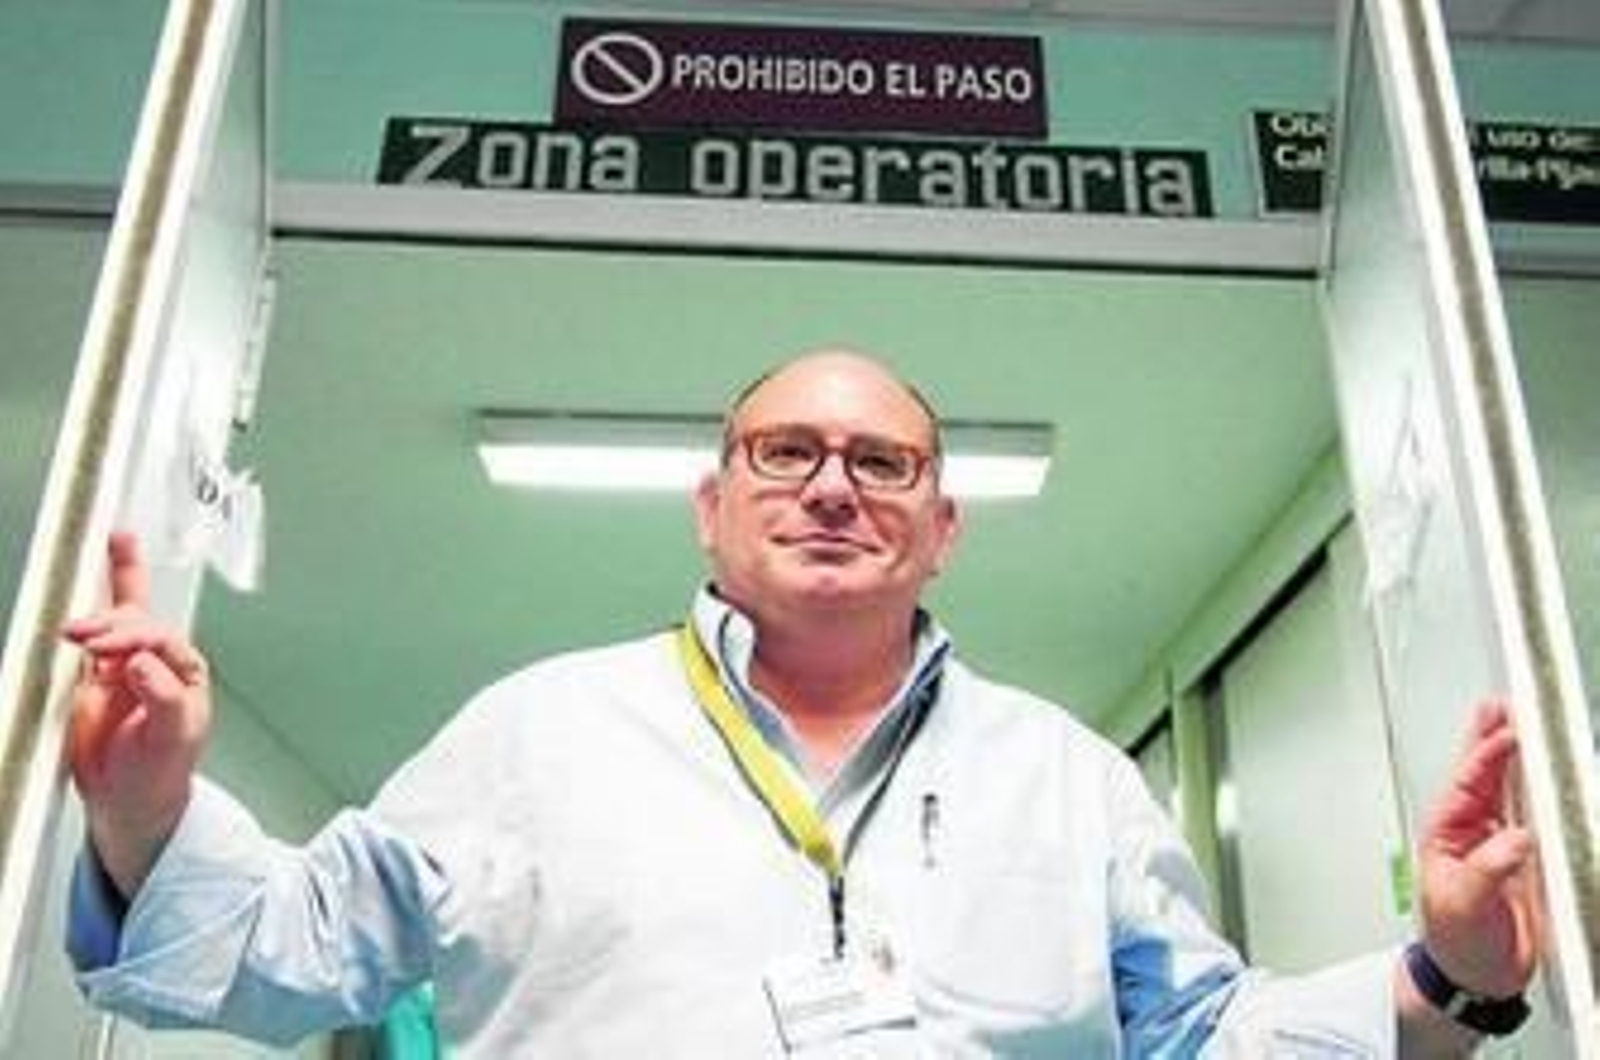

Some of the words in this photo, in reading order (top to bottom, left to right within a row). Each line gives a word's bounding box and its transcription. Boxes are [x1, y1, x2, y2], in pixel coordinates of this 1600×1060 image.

[671, 54, 873, 96] PROHIBIDO
[885, 62, 925, 97] EL
[935, 65, 1033, 103] PASO
[401, 125, 639, 190] Zona
[692, 140, 1198, 217] operatoria
